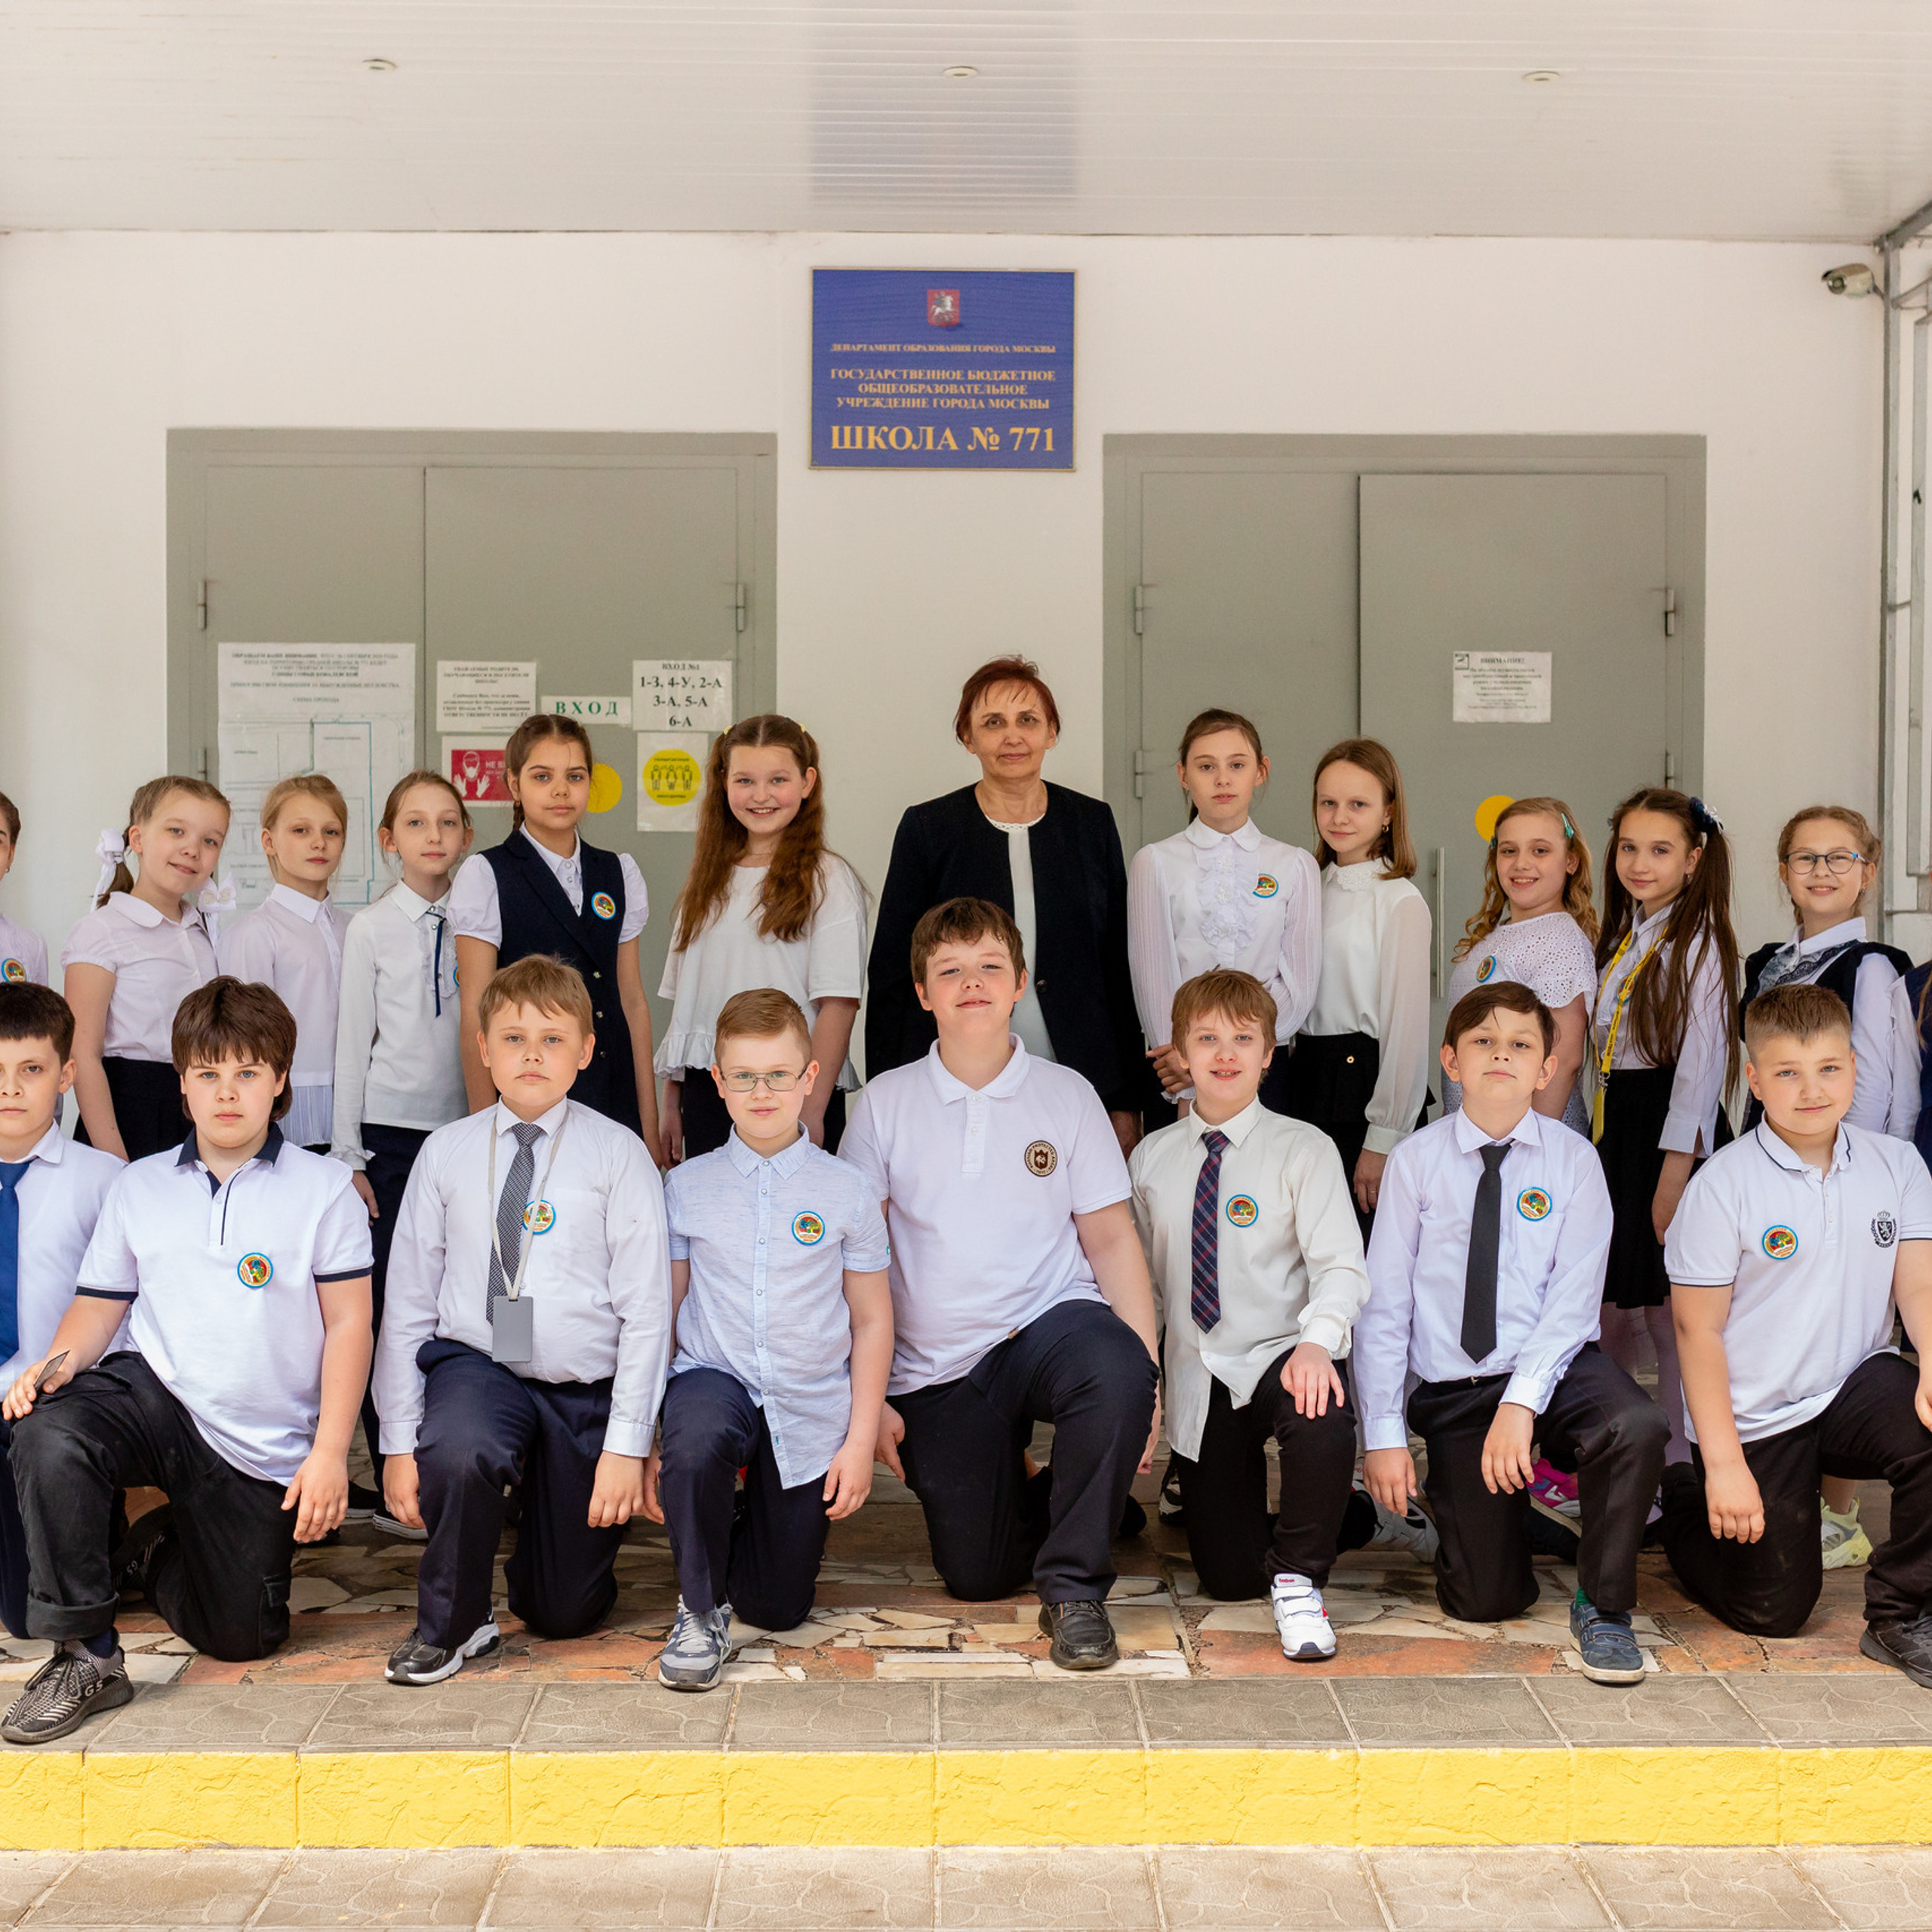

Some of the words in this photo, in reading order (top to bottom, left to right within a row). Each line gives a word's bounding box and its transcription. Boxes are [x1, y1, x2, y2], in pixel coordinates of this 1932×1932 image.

[831, 343, 901, 352] ДЕПАРТАМЕНТ
[973, 345, 1011, 353] ГОРОДА
[1012, 345, 1056, 353] МОСКВЫ
[831, 368, 964, 380] ГОСУДАРСТВЕННОЕ
[968, 370, 1056, 381] БЮДЖЕТНОЕ
[857, 383, 1028, 395] ОБЩЕОБРАЗОВАТЕЛЬНОЕ
[837, 397, 930, 409] УЧРЕЖДЕНИЕ
[933, 398, 986, 410] ГОРОДА
[989, 398, 1050, 409] МОСКВЫ
[831, 425, 959, 451] ШКОЛА
[967, 426, 1000, 451] №
[1008, 426, 1054, 451] 771
[555, 701, 618, 716] ВХОД
[669, 715, 692, 727] 6-А
